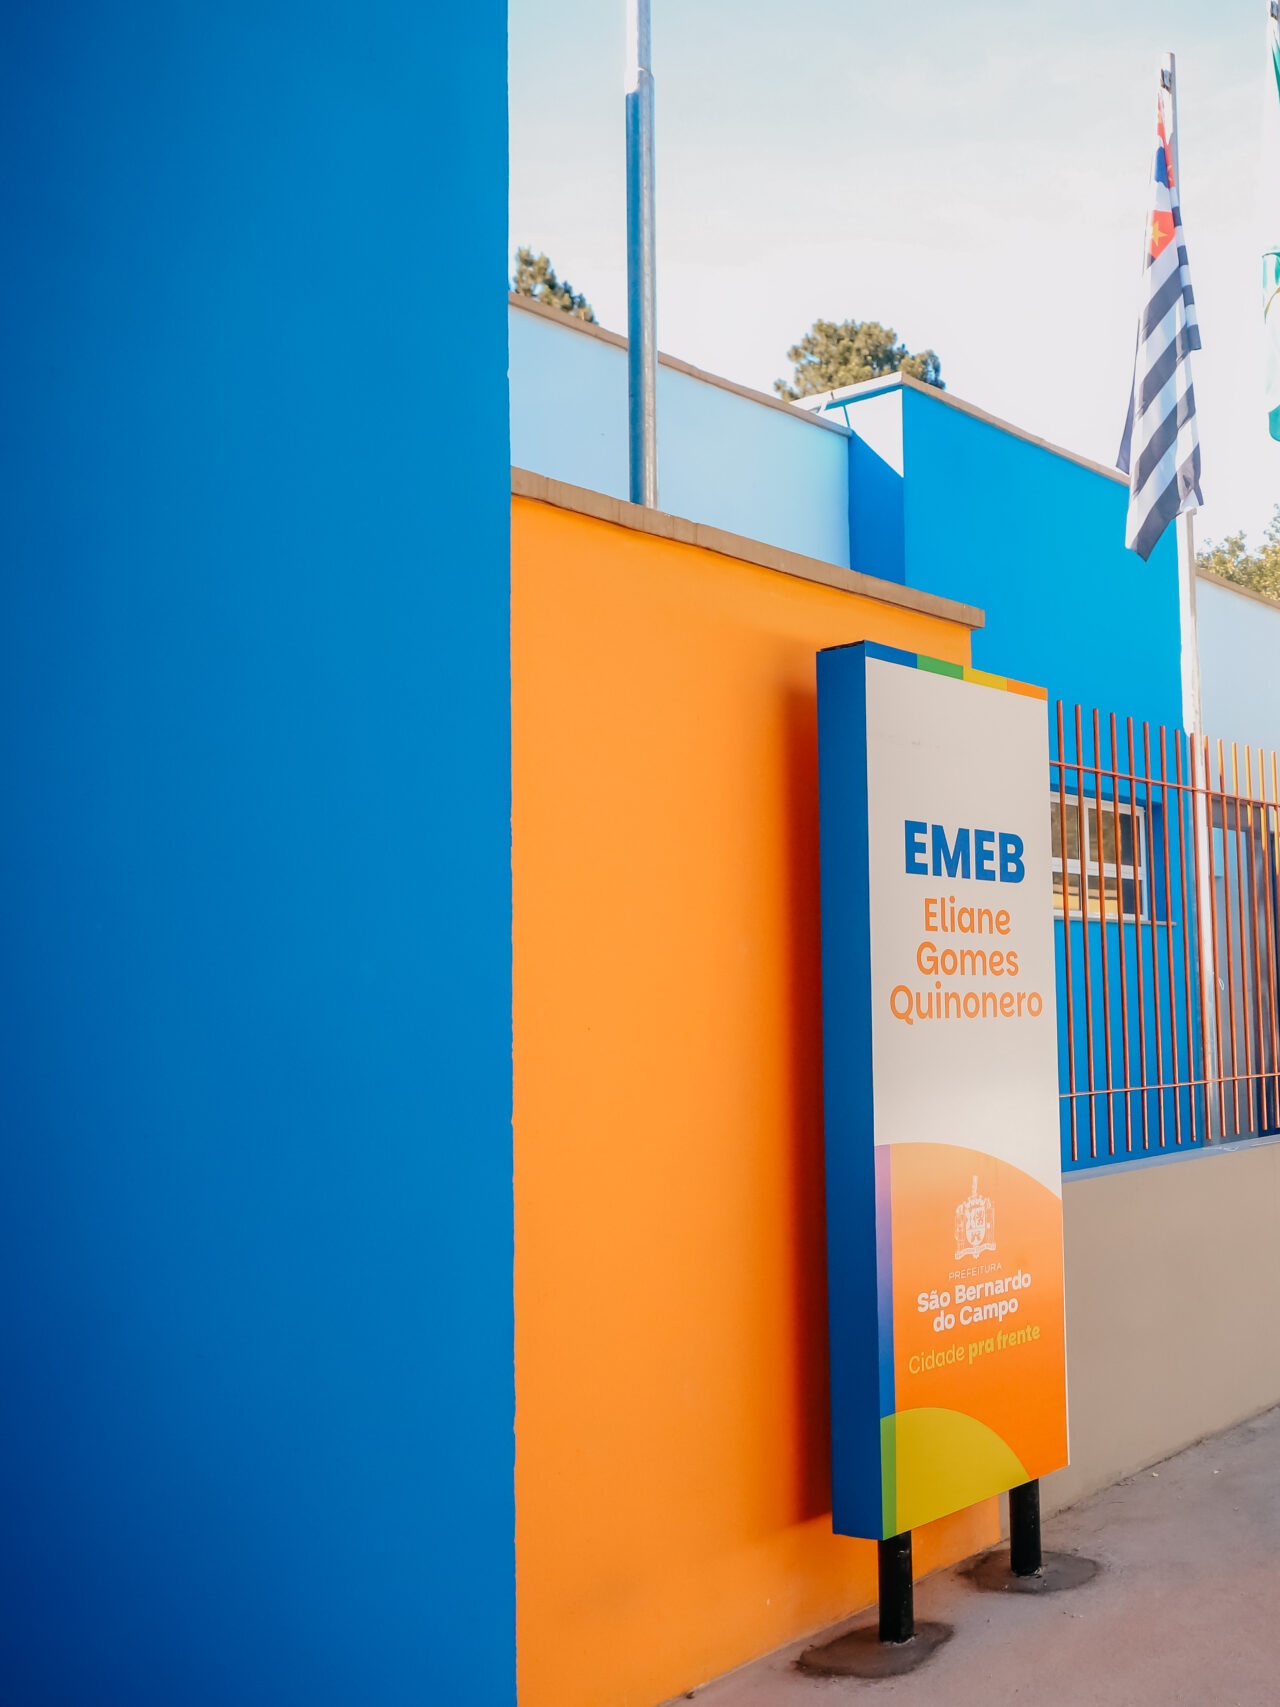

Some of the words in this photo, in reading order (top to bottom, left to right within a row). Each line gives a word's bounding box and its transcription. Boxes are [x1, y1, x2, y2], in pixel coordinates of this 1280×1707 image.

[904, 819, 1026, 884] EMEB
[924, 895, 1011, 935] Eliane
[916, 941, 1019, 977] Gomes
[889, 980, 1043, 1026] Quinonero
[916, 1290, 951, 1313] São
[954, 1269, 1032, 1304] Bernardo
[948, 1262, 1002, 1281] PREFEITURA
[933, 1310, 955, 1332] do
[959, 1297, 1019, 1326] Campo
[908, 1343, 965, 1375] Cidade
[967, 1338, 994, 1365] pra
[996, 1324, 1041, 1349] frente
